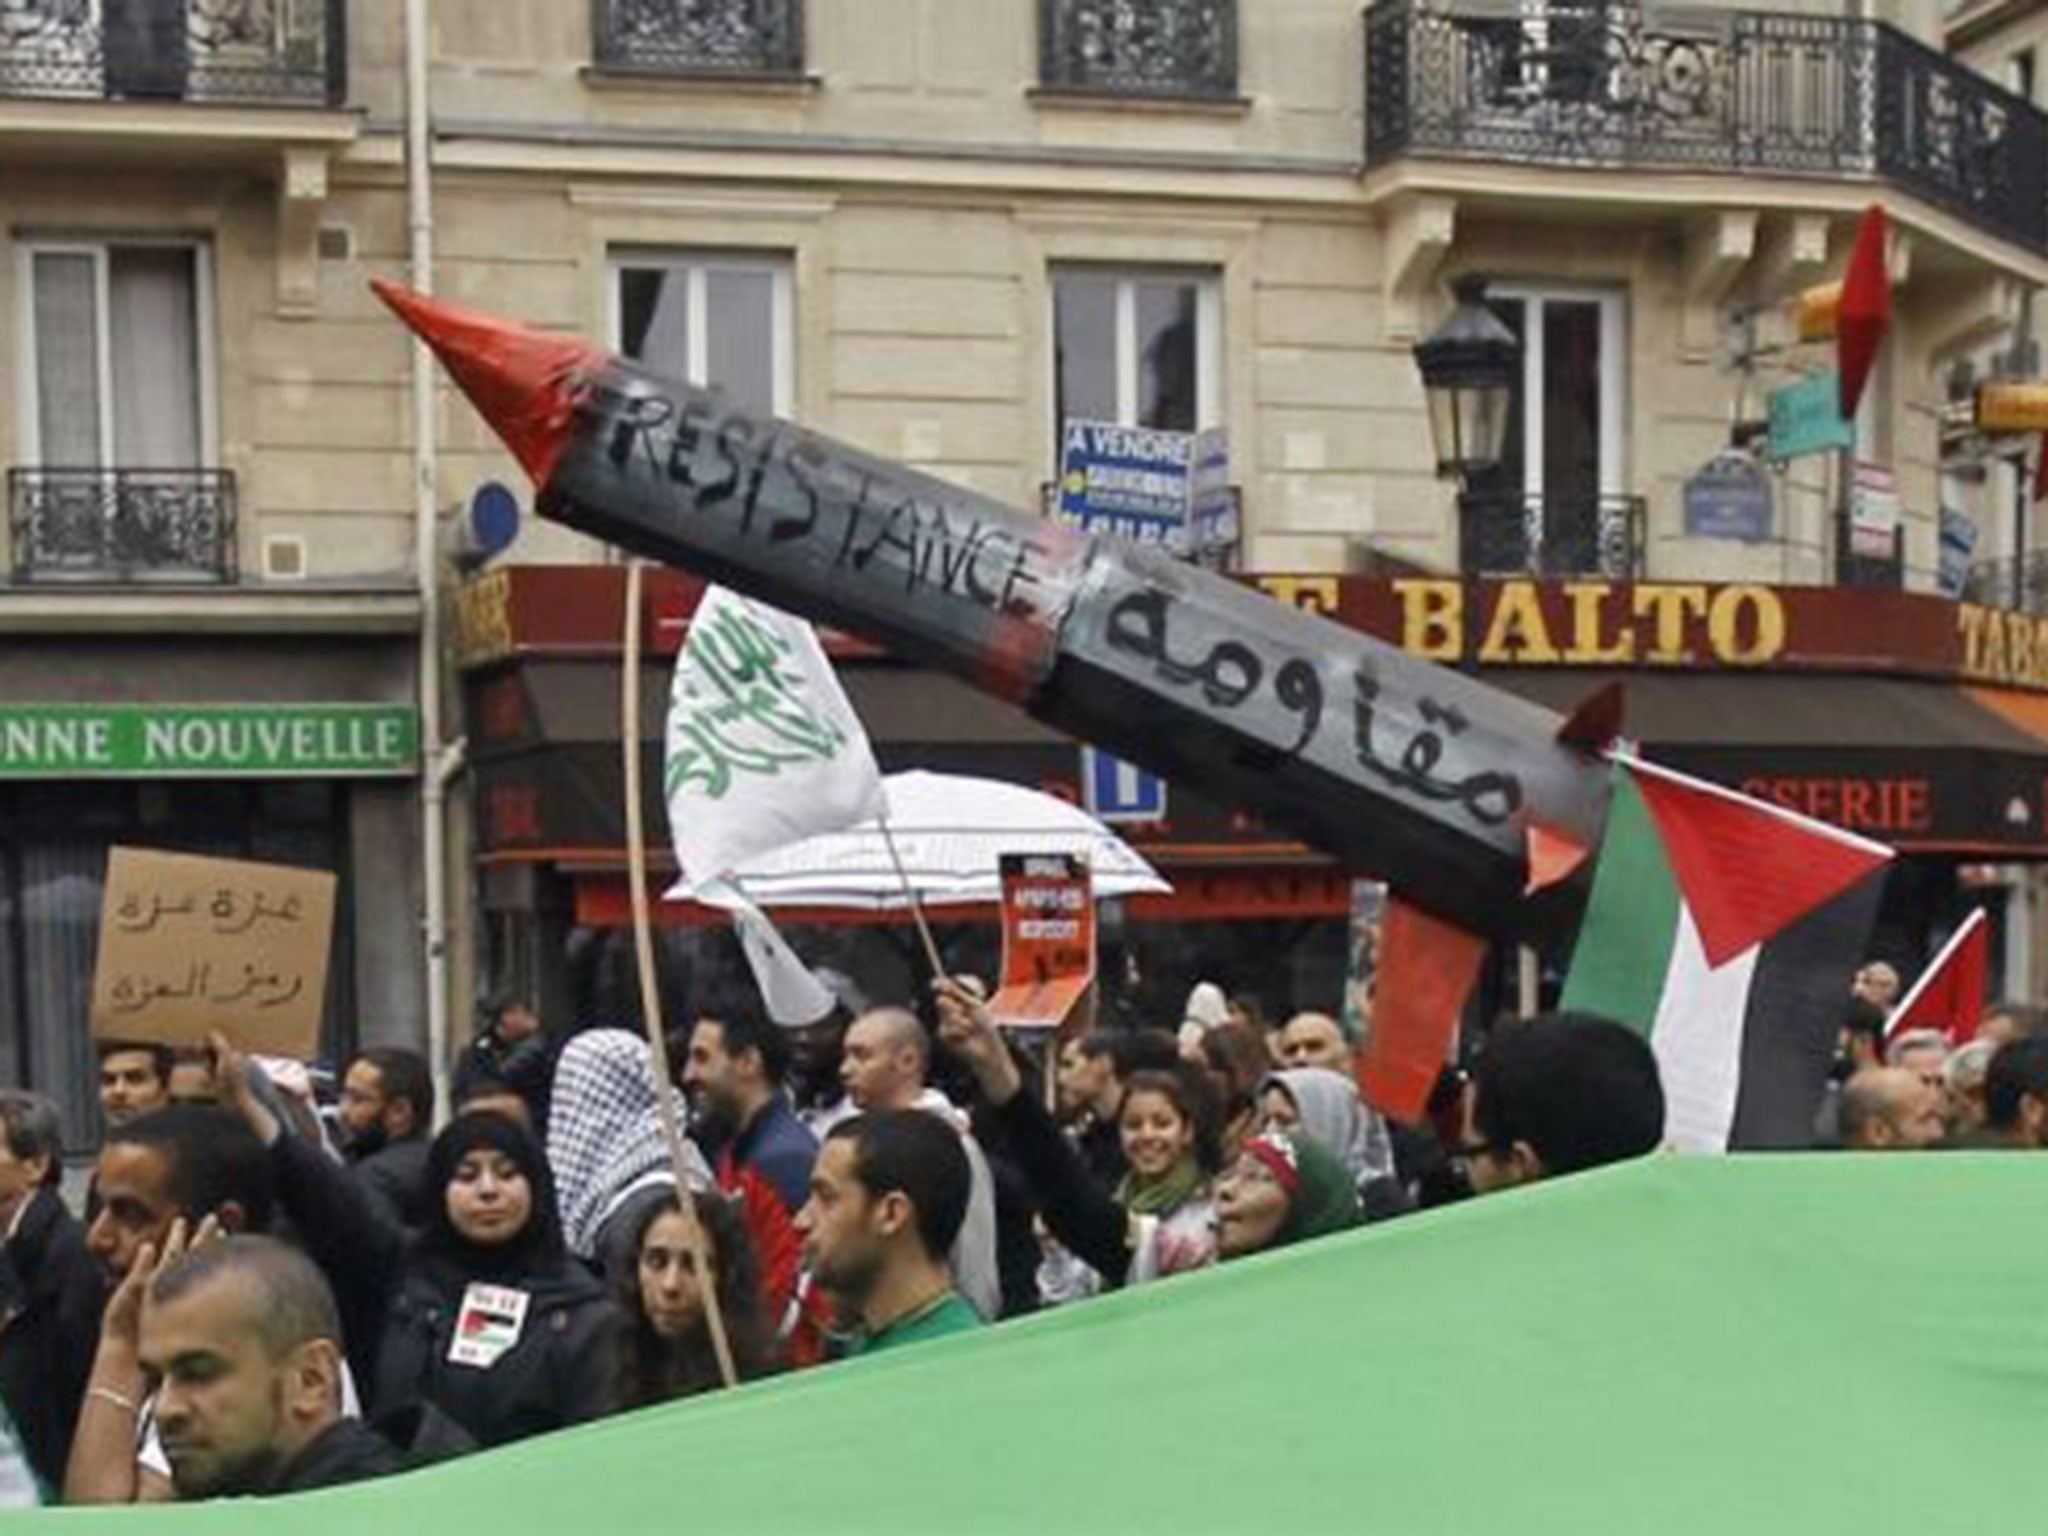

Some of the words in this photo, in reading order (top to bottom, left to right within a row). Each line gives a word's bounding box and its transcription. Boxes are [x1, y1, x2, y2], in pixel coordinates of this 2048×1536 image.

[1068, 426, 1088, 452] A
[1092, 428, 1192, 466] VENDRE
[604, 396, 1048, 616] RESISTANCE
[1393, 579, 1786, 667] BALTO
[1958, 602, 2048, 686] TAB
[0, 717, 111, 763] NNE
[143, 716, 403, 763] NOUVELLE
